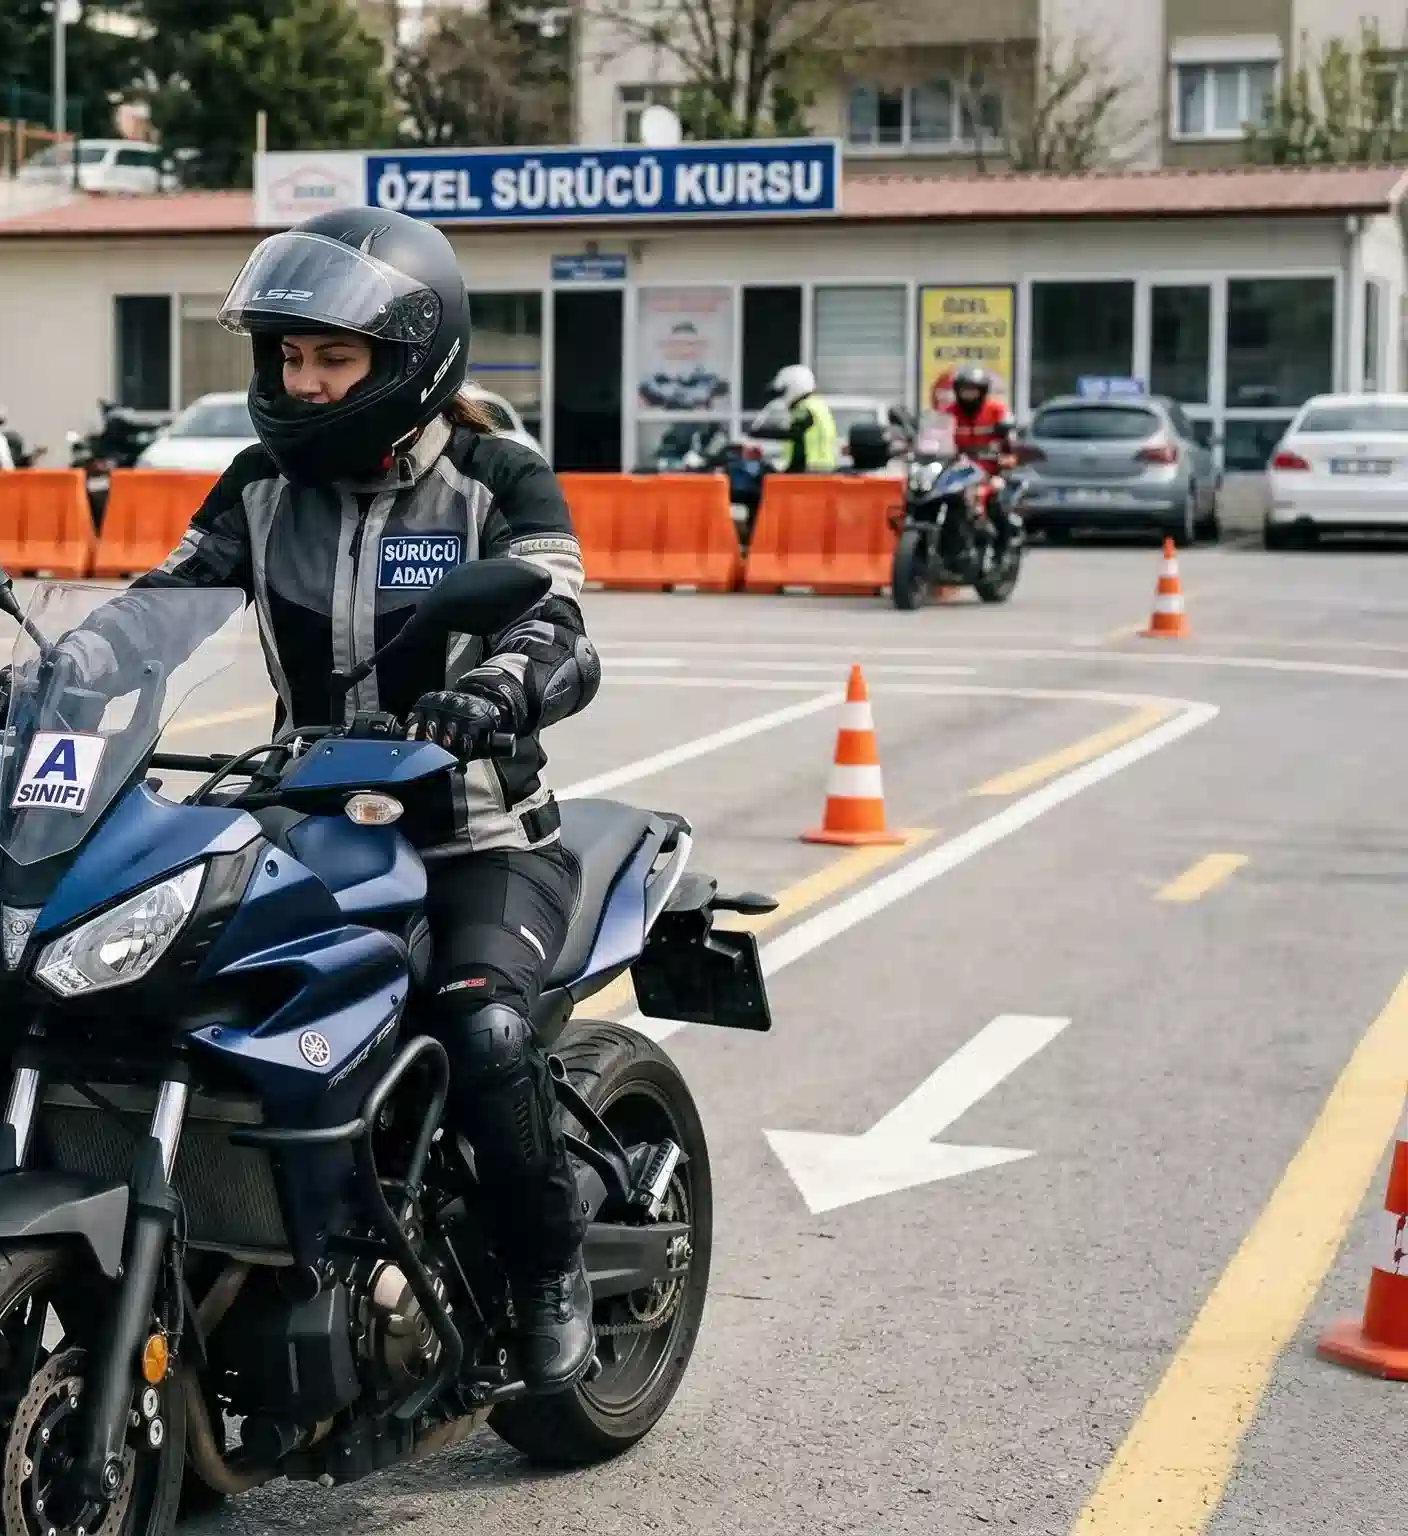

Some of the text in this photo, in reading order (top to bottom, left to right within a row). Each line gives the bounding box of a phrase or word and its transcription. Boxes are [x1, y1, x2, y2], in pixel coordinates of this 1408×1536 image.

[377, 156, 823, 211] ÖZEL SÜRÜCÜ KURSU
[252, 288, 314, 302] LS2
[420, 337, 461, 404] LS2
[384, 539, 457, 562] SÜRÜCÜ
[32, 738, 78, 782] A
[17, 783, 86, 806] SINIFI
